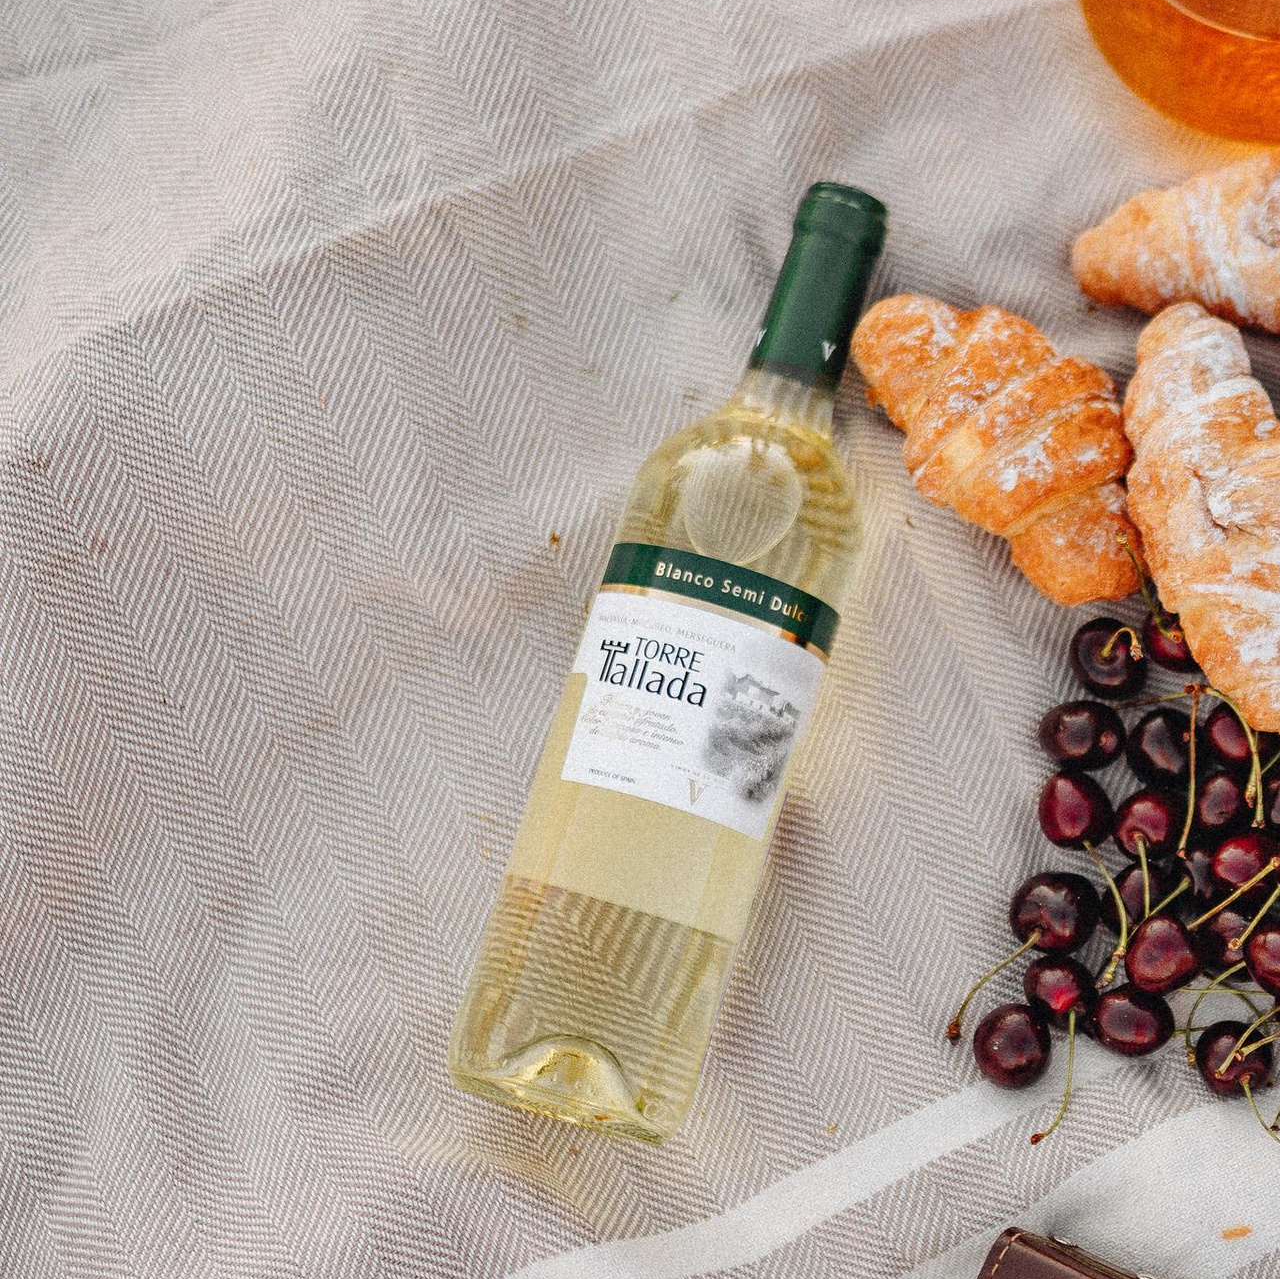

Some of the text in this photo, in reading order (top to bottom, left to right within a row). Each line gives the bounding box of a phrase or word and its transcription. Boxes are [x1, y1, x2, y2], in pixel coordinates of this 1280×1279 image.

[655, 561, 714, 589] Blanco
[721, 579, 765, 605] Semi
[635, 636, 705, 673] TORRE
[676, 627, 736, 652] MERSEGUERA
[599, 639, 707, 707] Tallada
